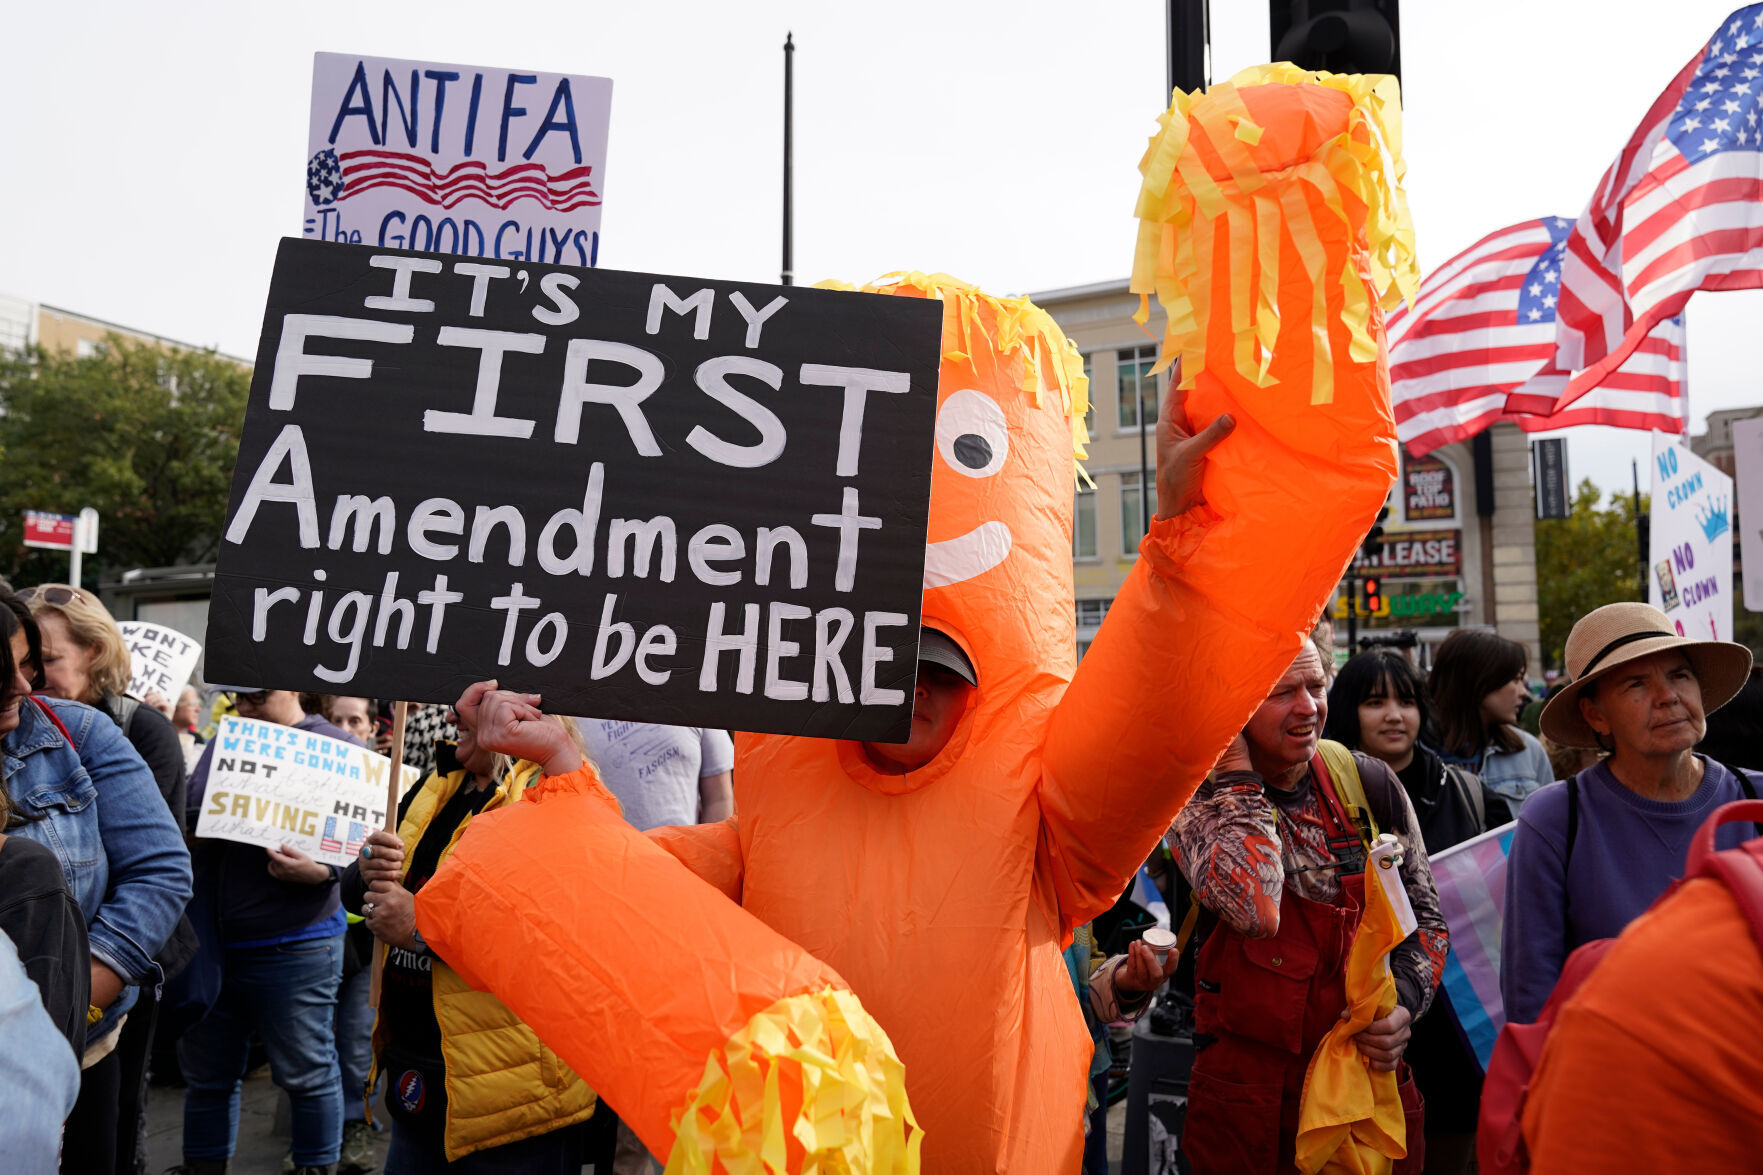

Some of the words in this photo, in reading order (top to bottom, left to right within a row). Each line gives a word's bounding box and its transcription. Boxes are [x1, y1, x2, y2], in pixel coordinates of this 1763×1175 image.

[328, 60, 582, 164] ANTIFA
[379, 210, 483, 256] GOOD
[495, 220, 598, 267] GUYS!
[364, 254, 581, 326] IT'S
[646, 283, 789, 349] MY
[269, 313, 911, 477] FIRST
[1657, 447, 1679, 482] NO
[225, 424, 882, 592] Amendment
[1410, 493, 1450, 508] PATIO
[1667, 471, 1703, 510] CROWN
[1382, 539, 1456, 566] LEASE
[1672, 541, 1694, 575] NO
[1682, 575, 1719, 608] CLOWN
[252, 569, 464, 683] right
[491, 582, 569, 667] to
[590, 593, 678, 686] be
[699, 602, 909, 705] HERE
[223, 736, 286, 760] WERE
[293, 751, 360, 780] GONNA
[306, 737, 350, 760] HOW
[638, 746, 680, 779] FASCISM
[217, 758, 278, 779] NOT
[208, 792, 319, 836] SAVING
